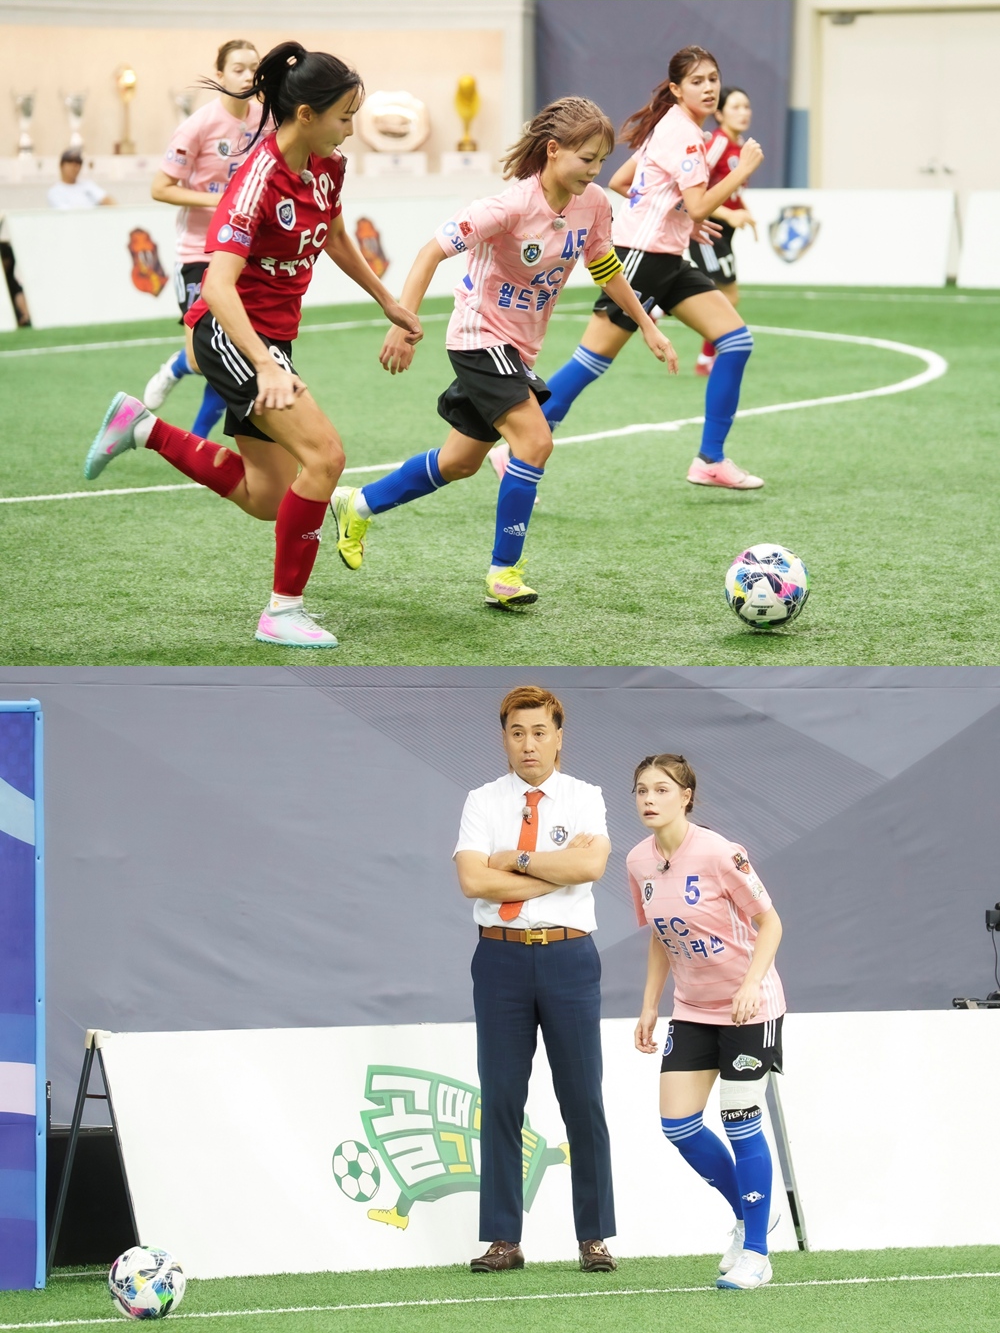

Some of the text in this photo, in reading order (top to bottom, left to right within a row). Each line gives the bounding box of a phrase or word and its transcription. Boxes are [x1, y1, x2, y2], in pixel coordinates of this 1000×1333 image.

[297, 223, 328, 254] FC
[561, 228, 587, 260] 45
[684, 875, 700, 905] 5
[653, 917, 689, 936] FC
